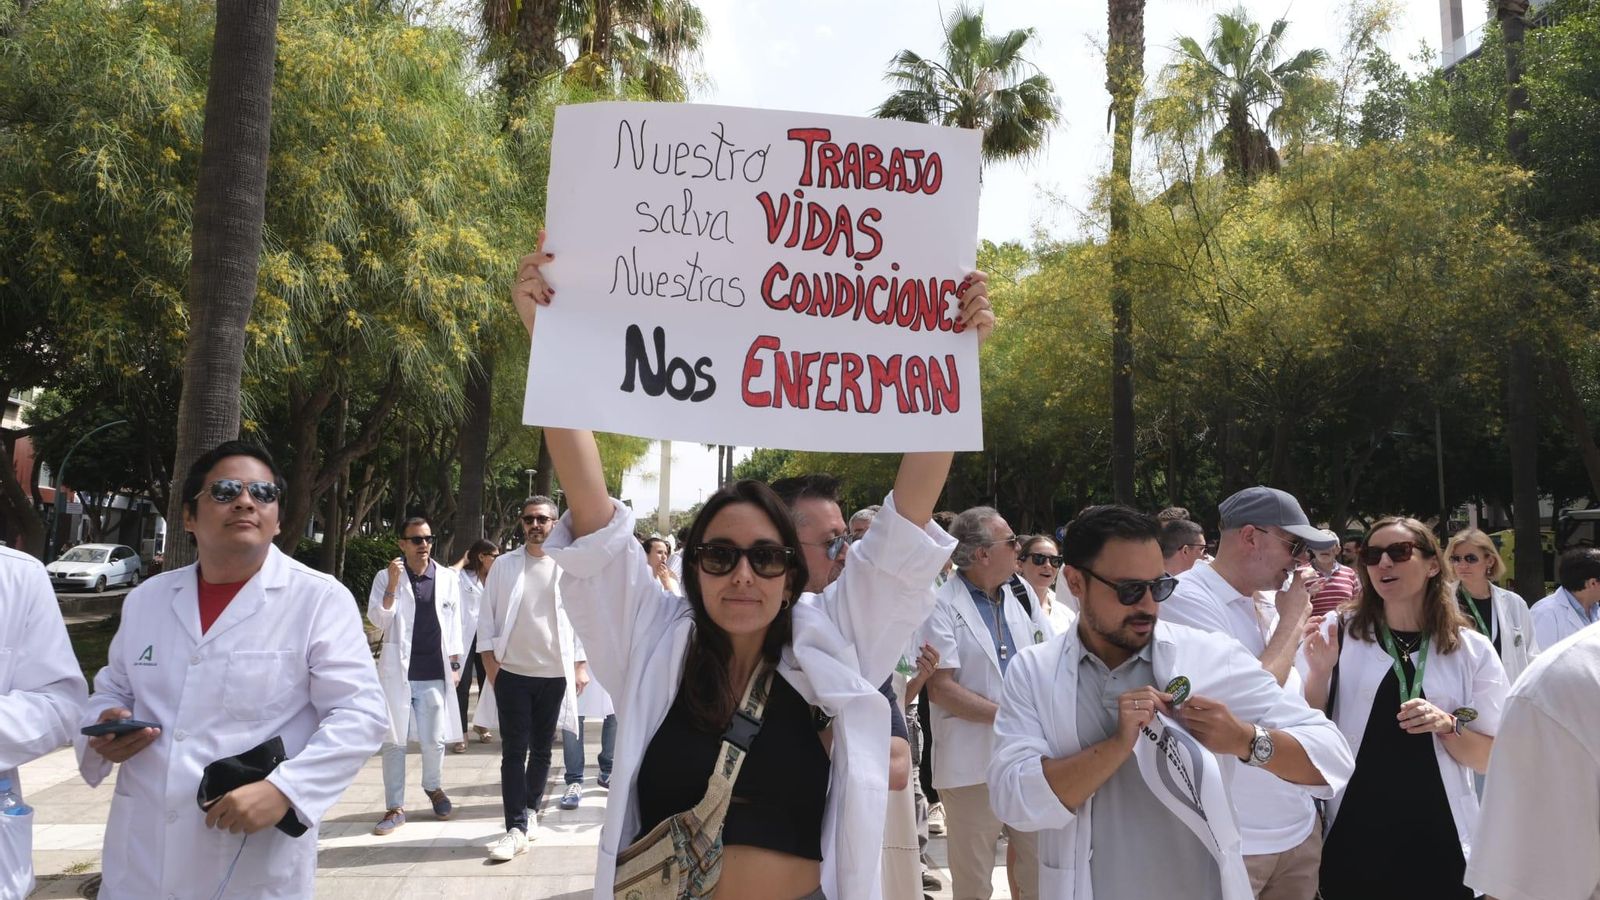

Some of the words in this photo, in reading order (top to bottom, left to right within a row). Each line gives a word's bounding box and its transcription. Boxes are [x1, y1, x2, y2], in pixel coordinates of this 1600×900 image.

[614, 119, 771, 182] Nuestro
[787, 128, 942, 195] TRABAJO
[636, 188, 734, 244] salva
[610, 246, 746, 308] Nuestras
[741, 335, 960, 415] ENFERMAN
[1142, 726, 1158, 741] NO
